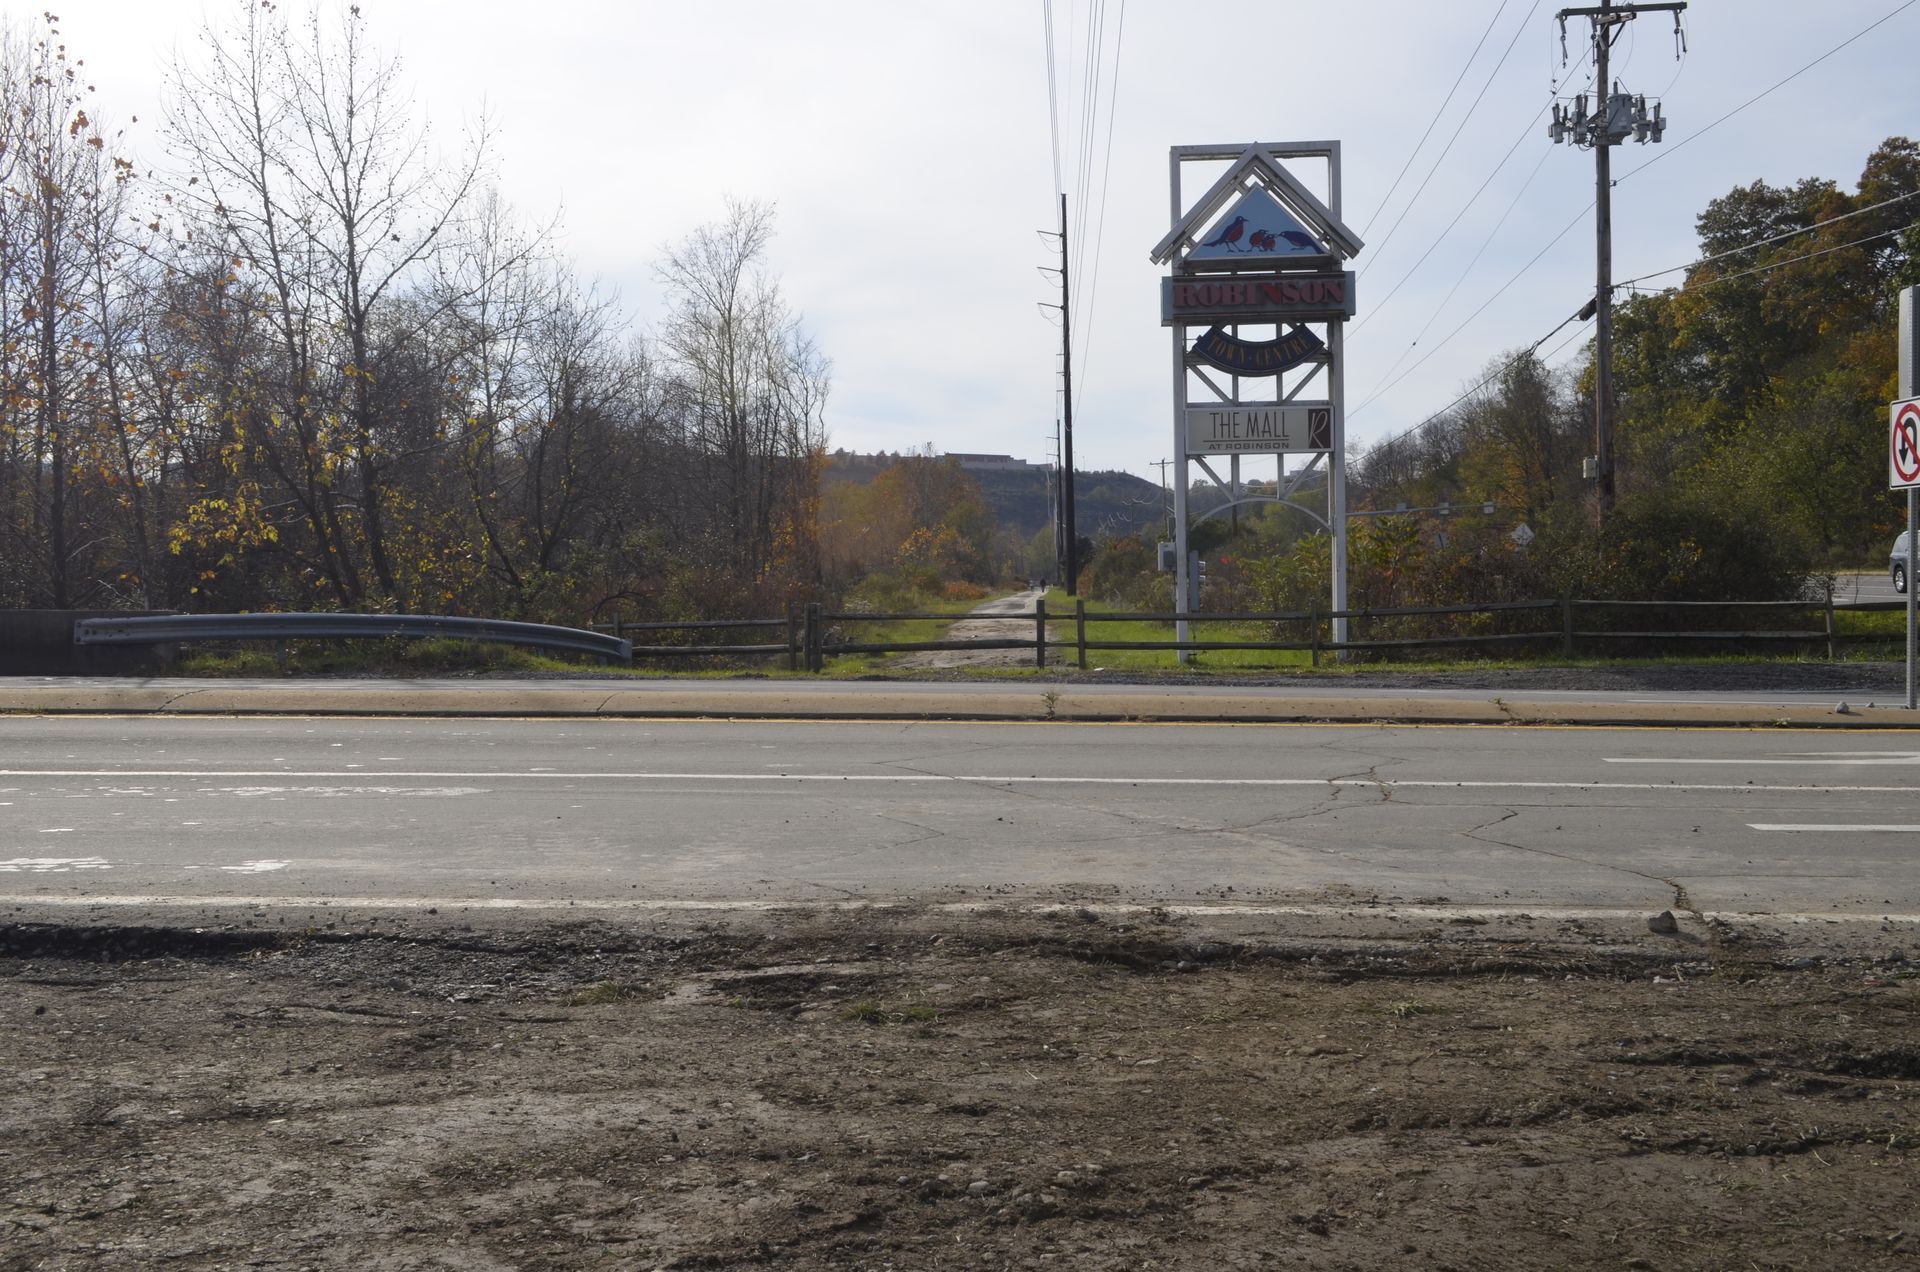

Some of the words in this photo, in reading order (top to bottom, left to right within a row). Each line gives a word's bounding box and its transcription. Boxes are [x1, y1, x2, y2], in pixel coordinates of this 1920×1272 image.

[1173, 280, 1345, 308] ROBINSON
[1207, 335, 1245, 364] TOWN
[1255, 334, 1311, 368] CENTRE
[1209, 411, 1240, 439] THE
[1246, 411, 1290, 438] MALL
[1208, 443, 1222, 451] AT
[1225, 442, 1290, 450] ROBINSON
